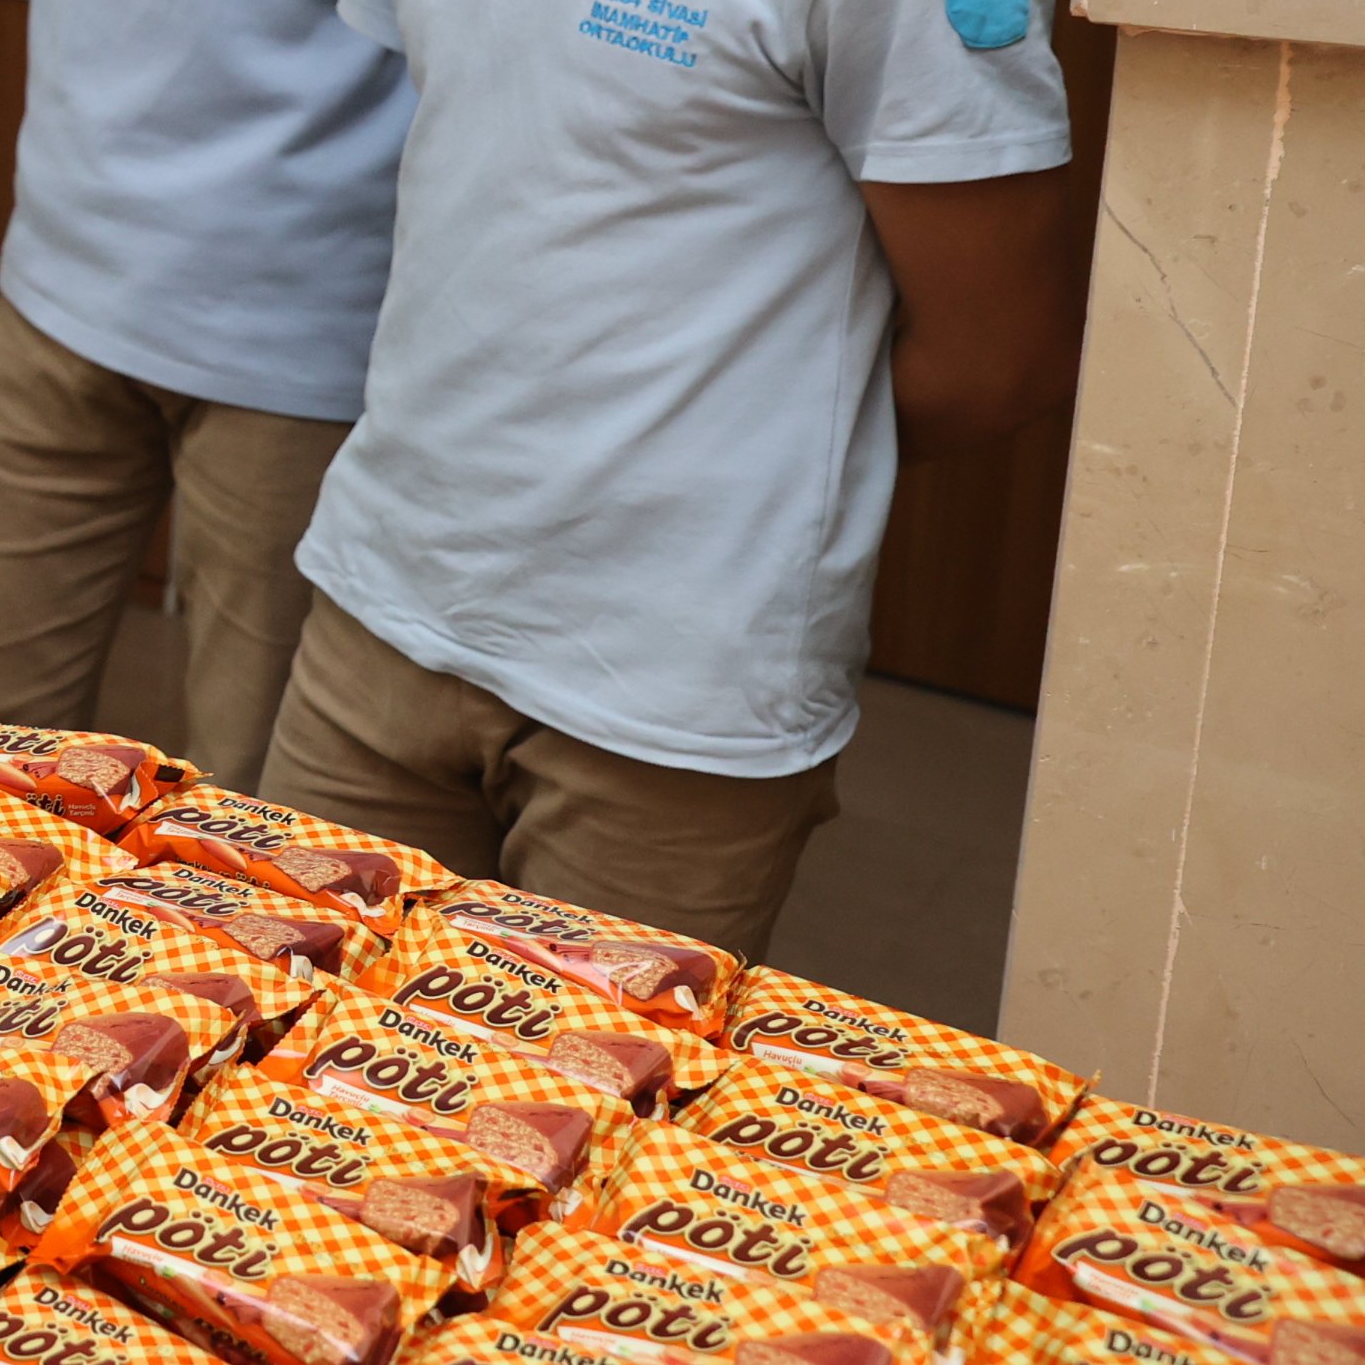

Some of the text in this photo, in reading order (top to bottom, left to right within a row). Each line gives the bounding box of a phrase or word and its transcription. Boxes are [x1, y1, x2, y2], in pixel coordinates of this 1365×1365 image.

[152, 806, 294, 850] pöti
[220, 797, 298, 826] Dankek
[99, 875, 248, 916] pöti
[173, 868, 255, 899] Dankek
[501, 893, 594, 926] Dankek
[75, 892, 158, 940] Dankek
[440, 901, 597, 942] pöti
[467, 941, 562, 994] Dankek
[392, 964, 563, 1041] pöti
[802, 1000, 908, 1042] Dankek
[378, 1009, 478, 1064] Dankek
[732, 1011, 909, 1069] pöti
[304, 1036, 478, 1114] pöti
[268, 1097, 372, 1146] Dankek
[775, 1087, 887, 1135] Dankek
[1133, 1111, 1256, 1150] Dankek
[204, 1124, 372, 1185] pöti
[709, 1113, 890, 1181] pöti
[173, 1168, 279, 1231] Dankek
[690, 1169, 806, 1226] Dankek
[96, 1198, 278, 1280] pöti
[621, 1199, 811, 1278] pöti
[1138, 1201, 1268, 1273] Dankek
[606, 1259, 724, 1304] Dankek
[1054, 1229, 1272, 1321] pöti
[33, 1287, 136, 1345] Dankek
[537, 1286, 732, 1351] pöti
